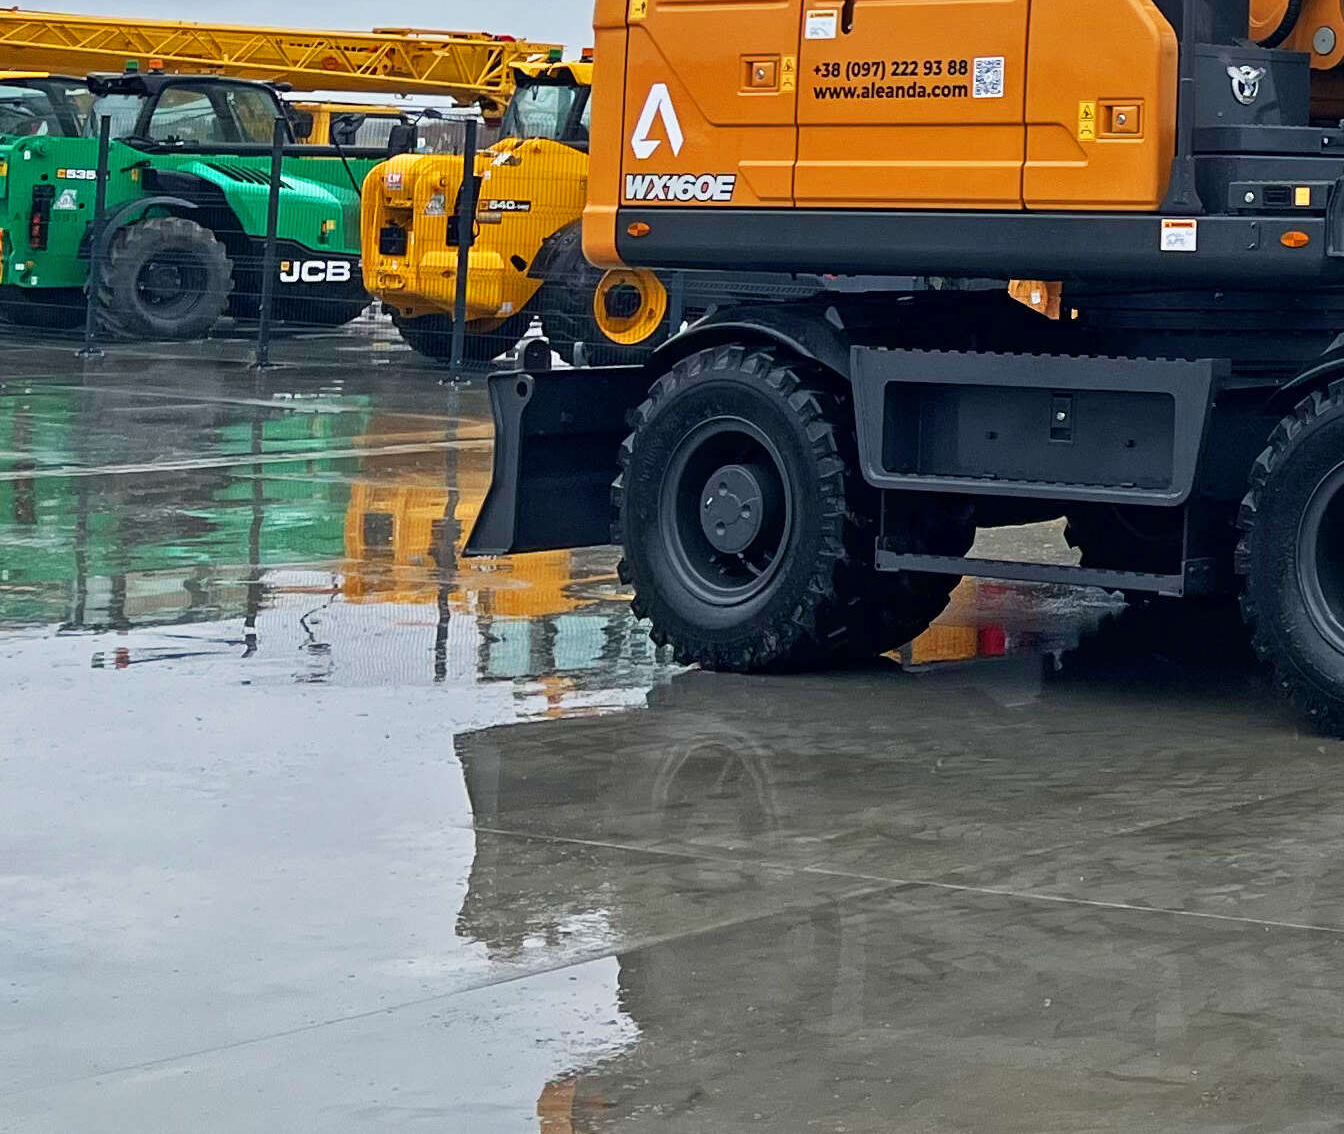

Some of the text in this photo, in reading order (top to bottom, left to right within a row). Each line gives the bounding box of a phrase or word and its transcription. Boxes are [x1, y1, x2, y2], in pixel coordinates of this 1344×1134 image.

[813, 60, 968, 81] +38 (097) 222 93 88
[813, 82, 968, 99] www.aleanda.com
[625, 173, 737, 202] WX160E
[280, 260, 351, 283] JCB
